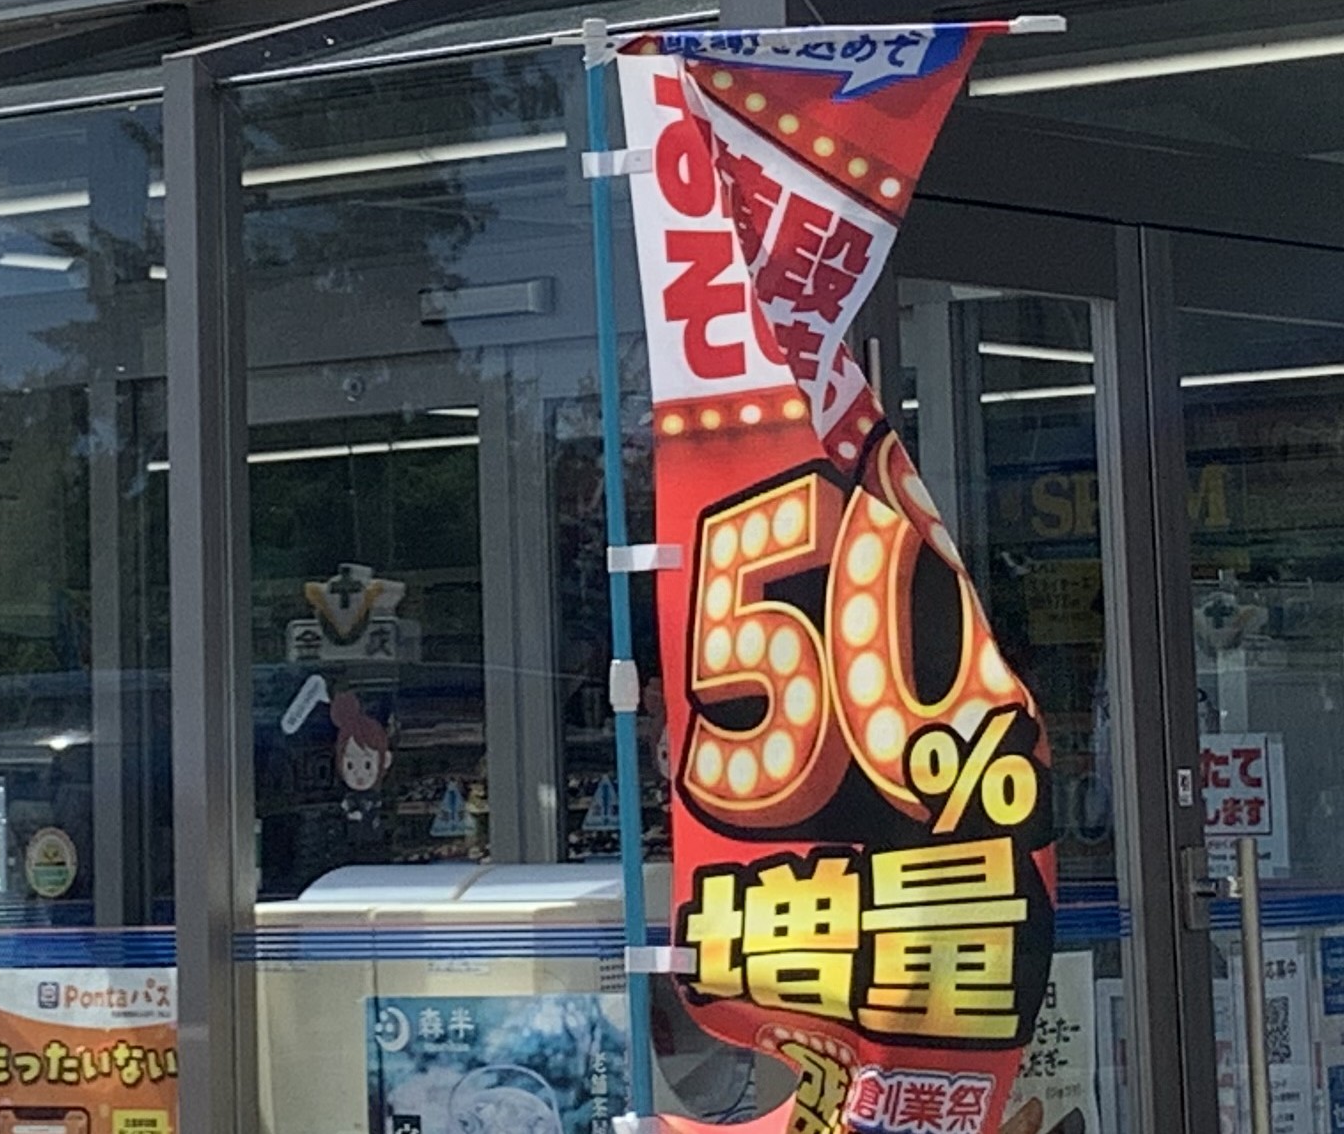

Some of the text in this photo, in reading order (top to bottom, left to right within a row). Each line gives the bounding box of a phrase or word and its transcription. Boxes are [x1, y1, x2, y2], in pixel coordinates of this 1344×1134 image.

[687, 836, 1028, 1040] 増量
[64, 977, 171, 1009] Pontaパス
[854, 1076, 987, 1133] 創業祭
